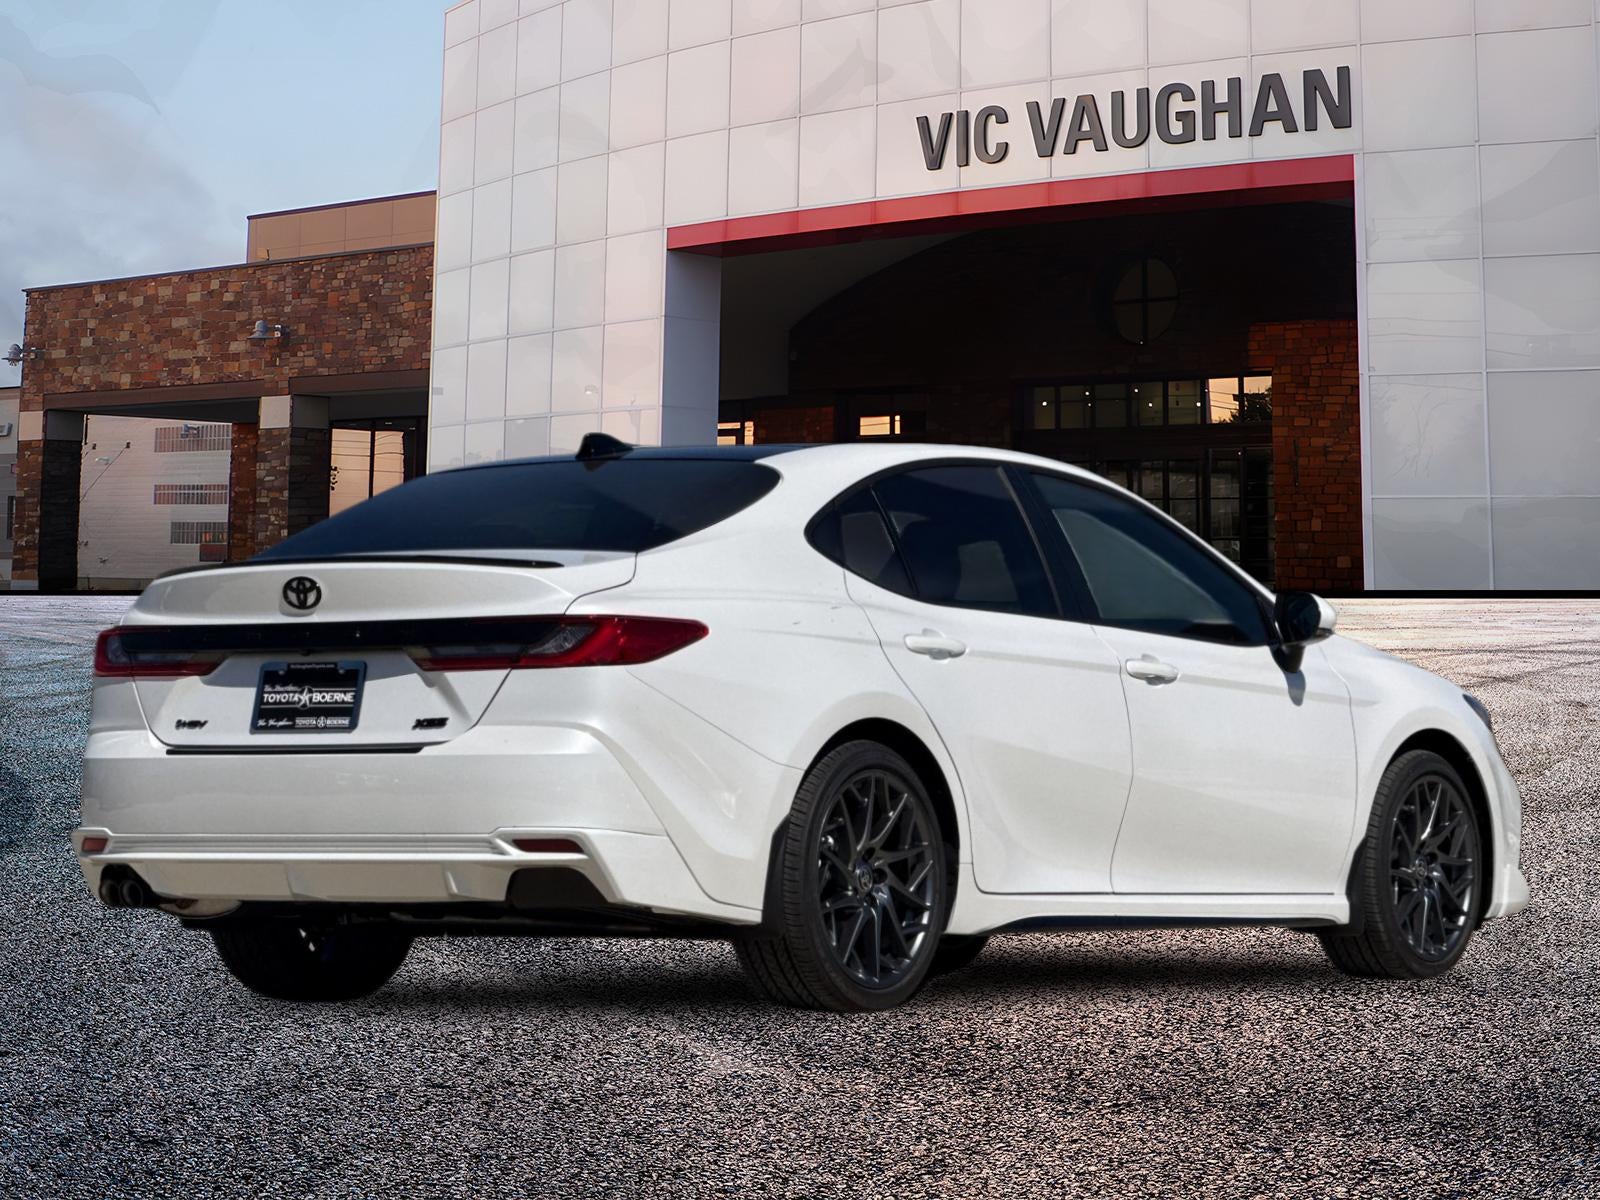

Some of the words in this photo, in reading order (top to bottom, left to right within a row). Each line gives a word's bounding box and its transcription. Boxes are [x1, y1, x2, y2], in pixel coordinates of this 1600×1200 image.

[916, 105, 1009, 171] VIC
[1025, 65, 1353, 158] VAUGHAN
[263, 693, 299, 703] TOYOTA
[312, 692, 355, 702] BOERNE
